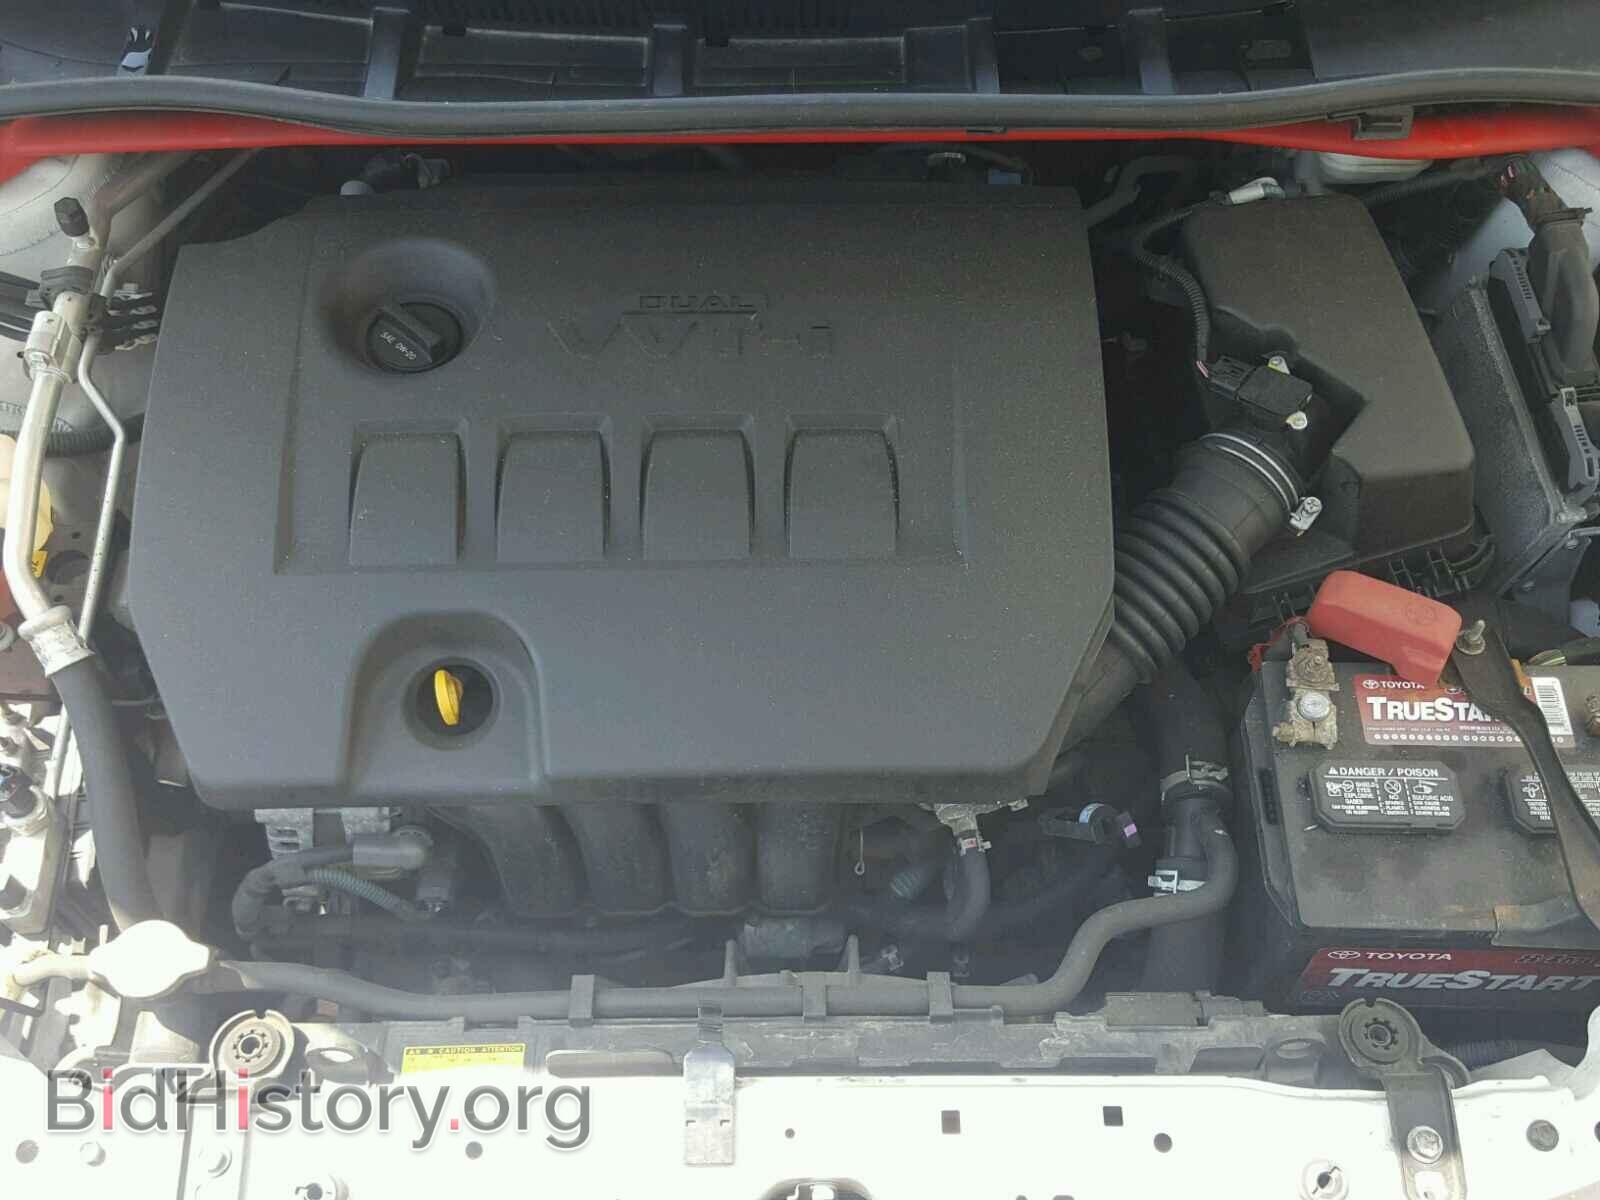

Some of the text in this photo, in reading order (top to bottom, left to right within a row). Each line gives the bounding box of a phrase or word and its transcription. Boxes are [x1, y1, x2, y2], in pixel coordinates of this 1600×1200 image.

[1366, 696, 1500, 721] TRUESTA
[1340, 767, 1386, 776] DANGER
[1396, 767, 1439, 777] POISON
[1365, 952, 1452, 961] TOYOTA
